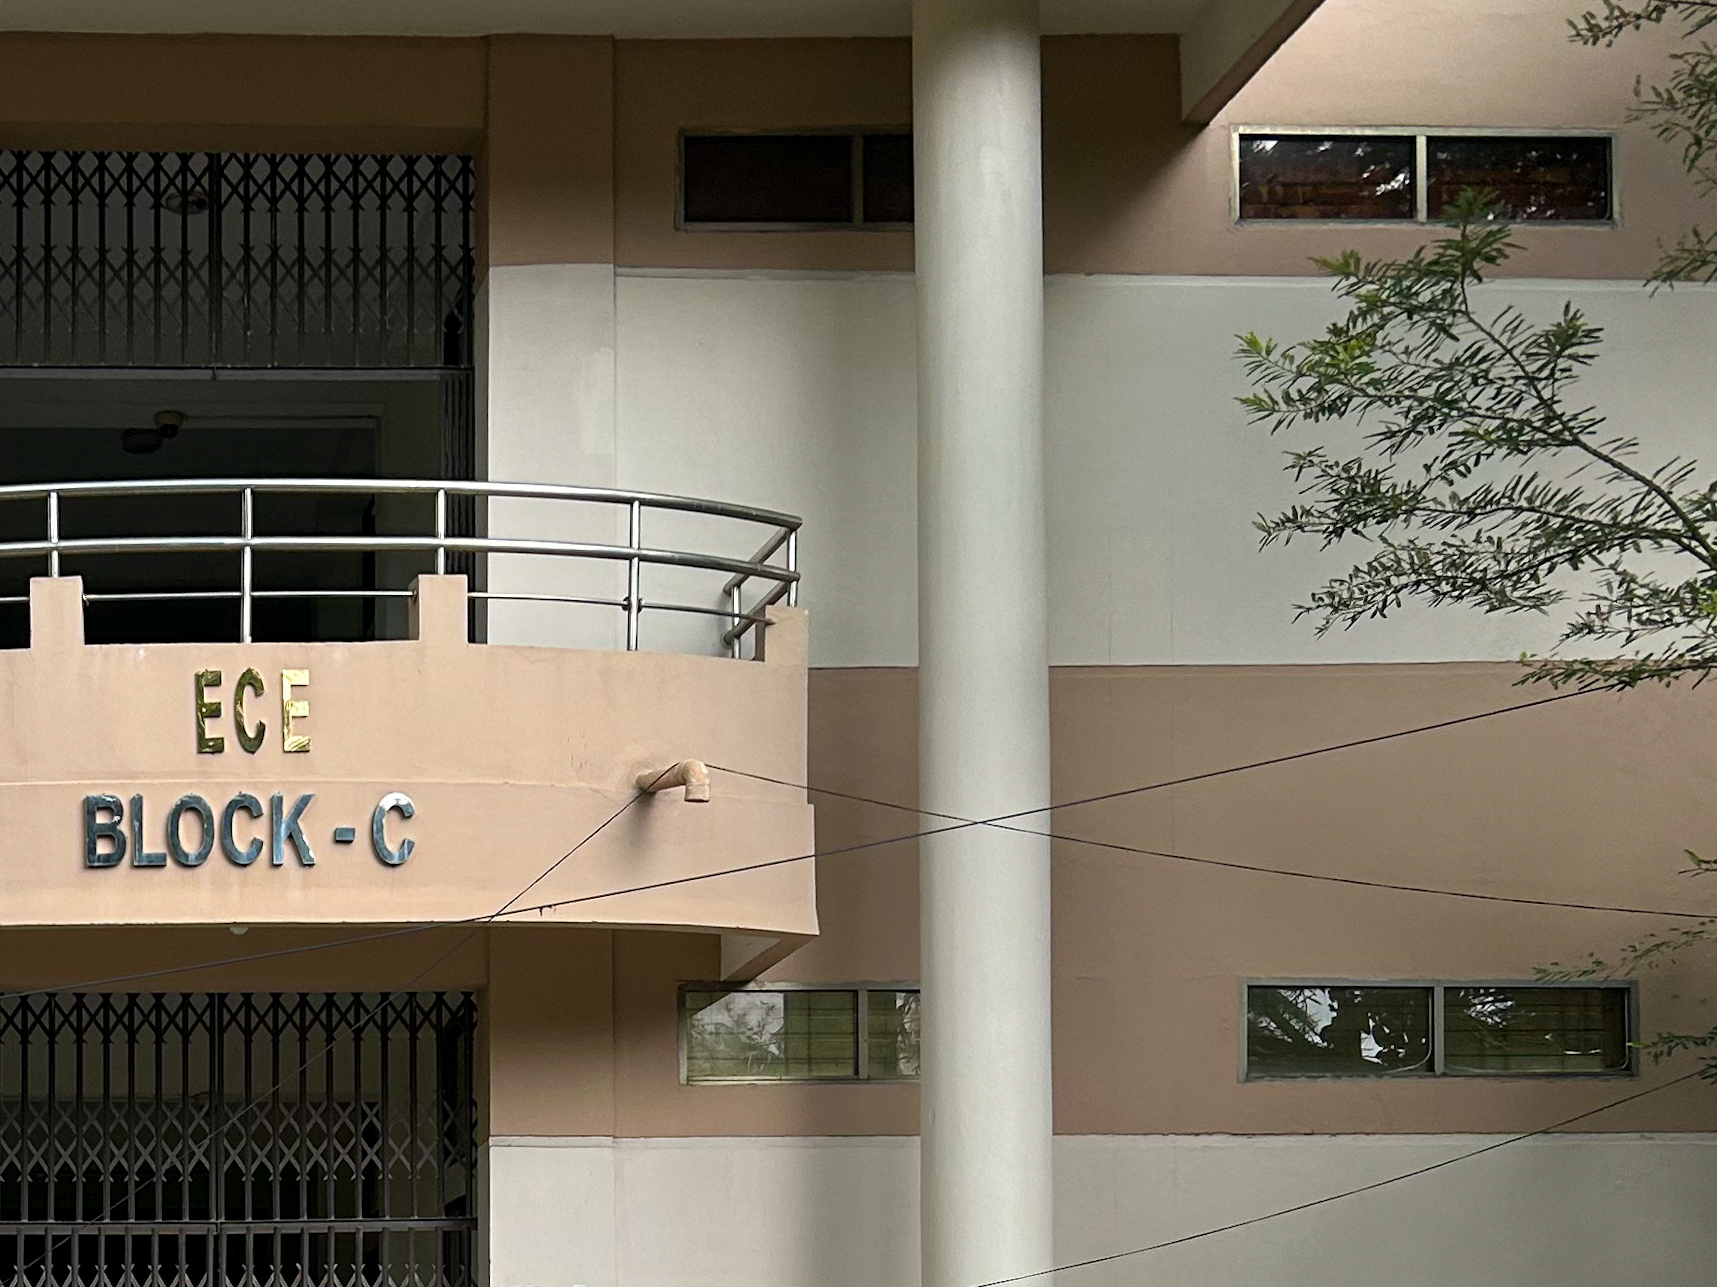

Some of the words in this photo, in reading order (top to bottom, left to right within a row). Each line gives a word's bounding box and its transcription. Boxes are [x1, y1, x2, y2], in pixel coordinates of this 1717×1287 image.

[194, 667, 311, 754] ECE
[83, 791, 316, 867] BLOCK
[371, 791, 416, 867] C
